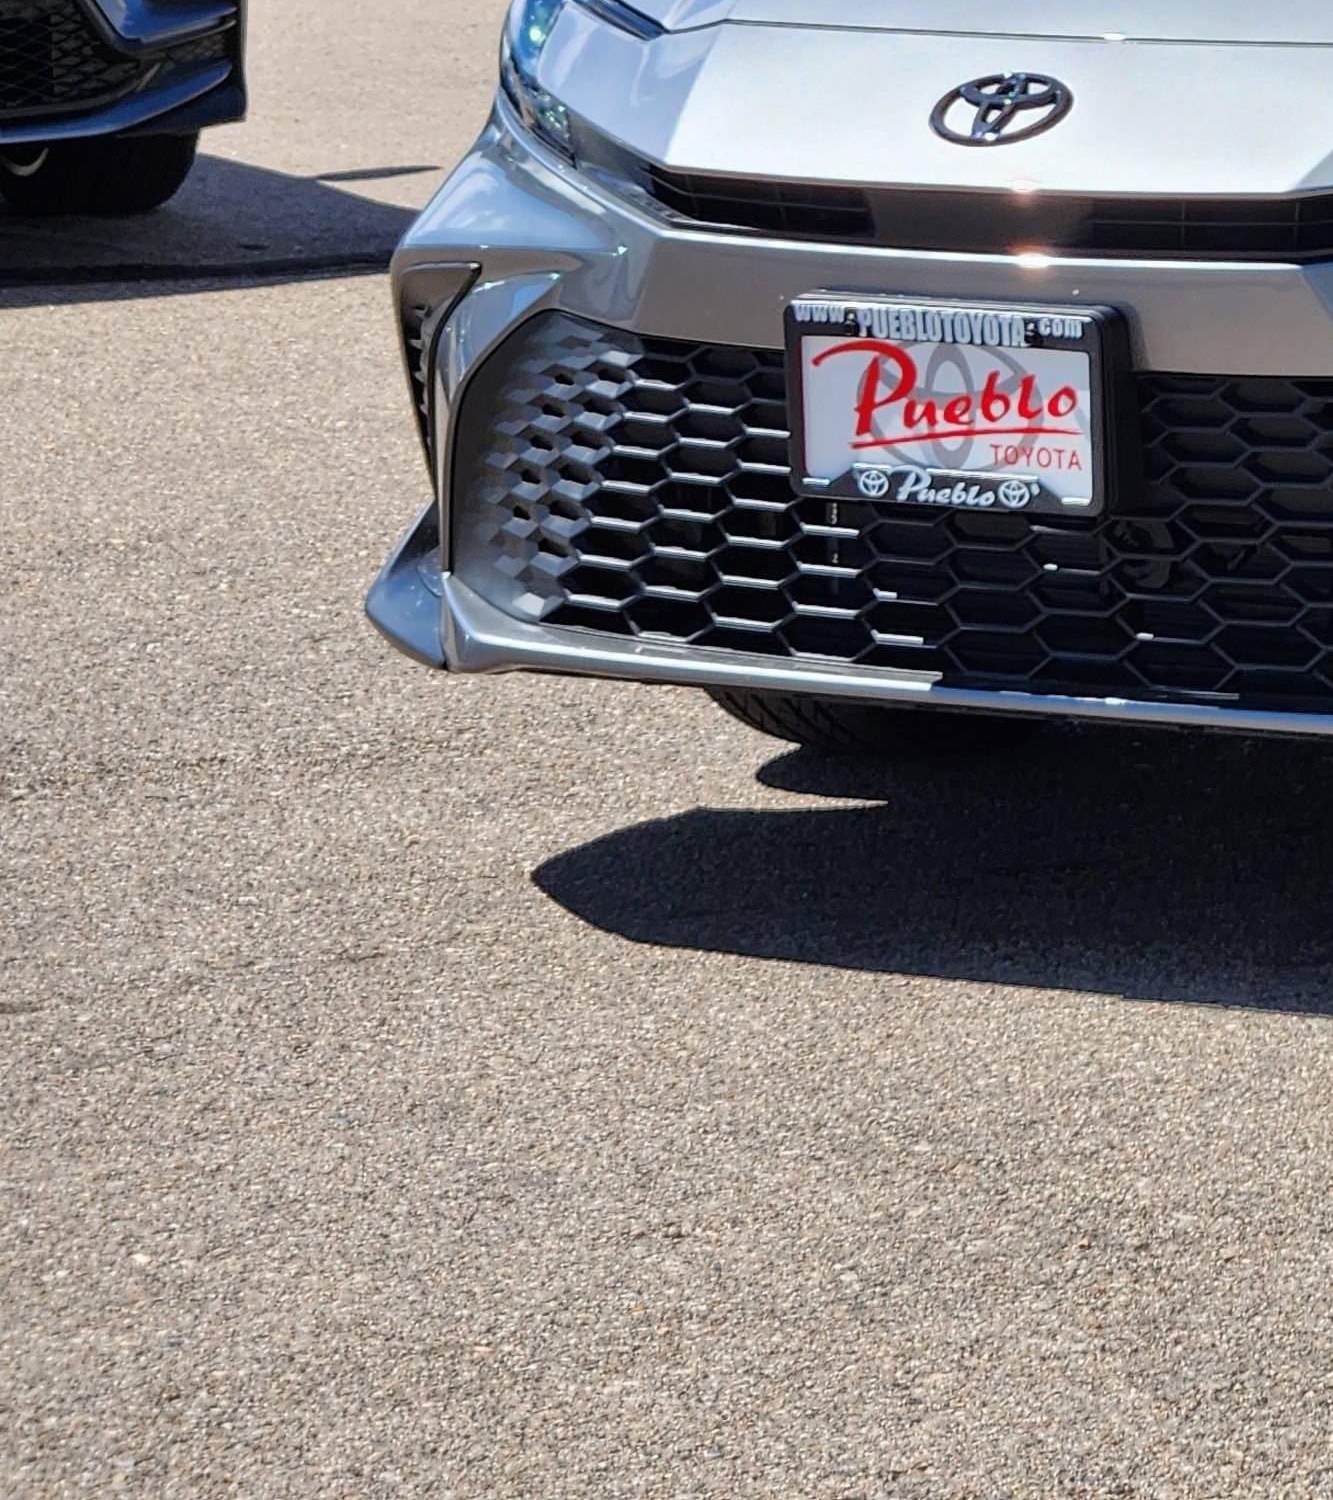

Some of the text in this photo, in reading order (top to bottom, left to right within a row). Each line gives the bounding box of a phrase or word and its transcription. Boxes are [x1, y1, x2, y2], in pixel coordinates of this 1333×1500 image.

[811, 338, 1079, 437] Pueblo
[989, 443, 1082, 471] TOYOTA
[890, 464, 996, 508] Pueblo
